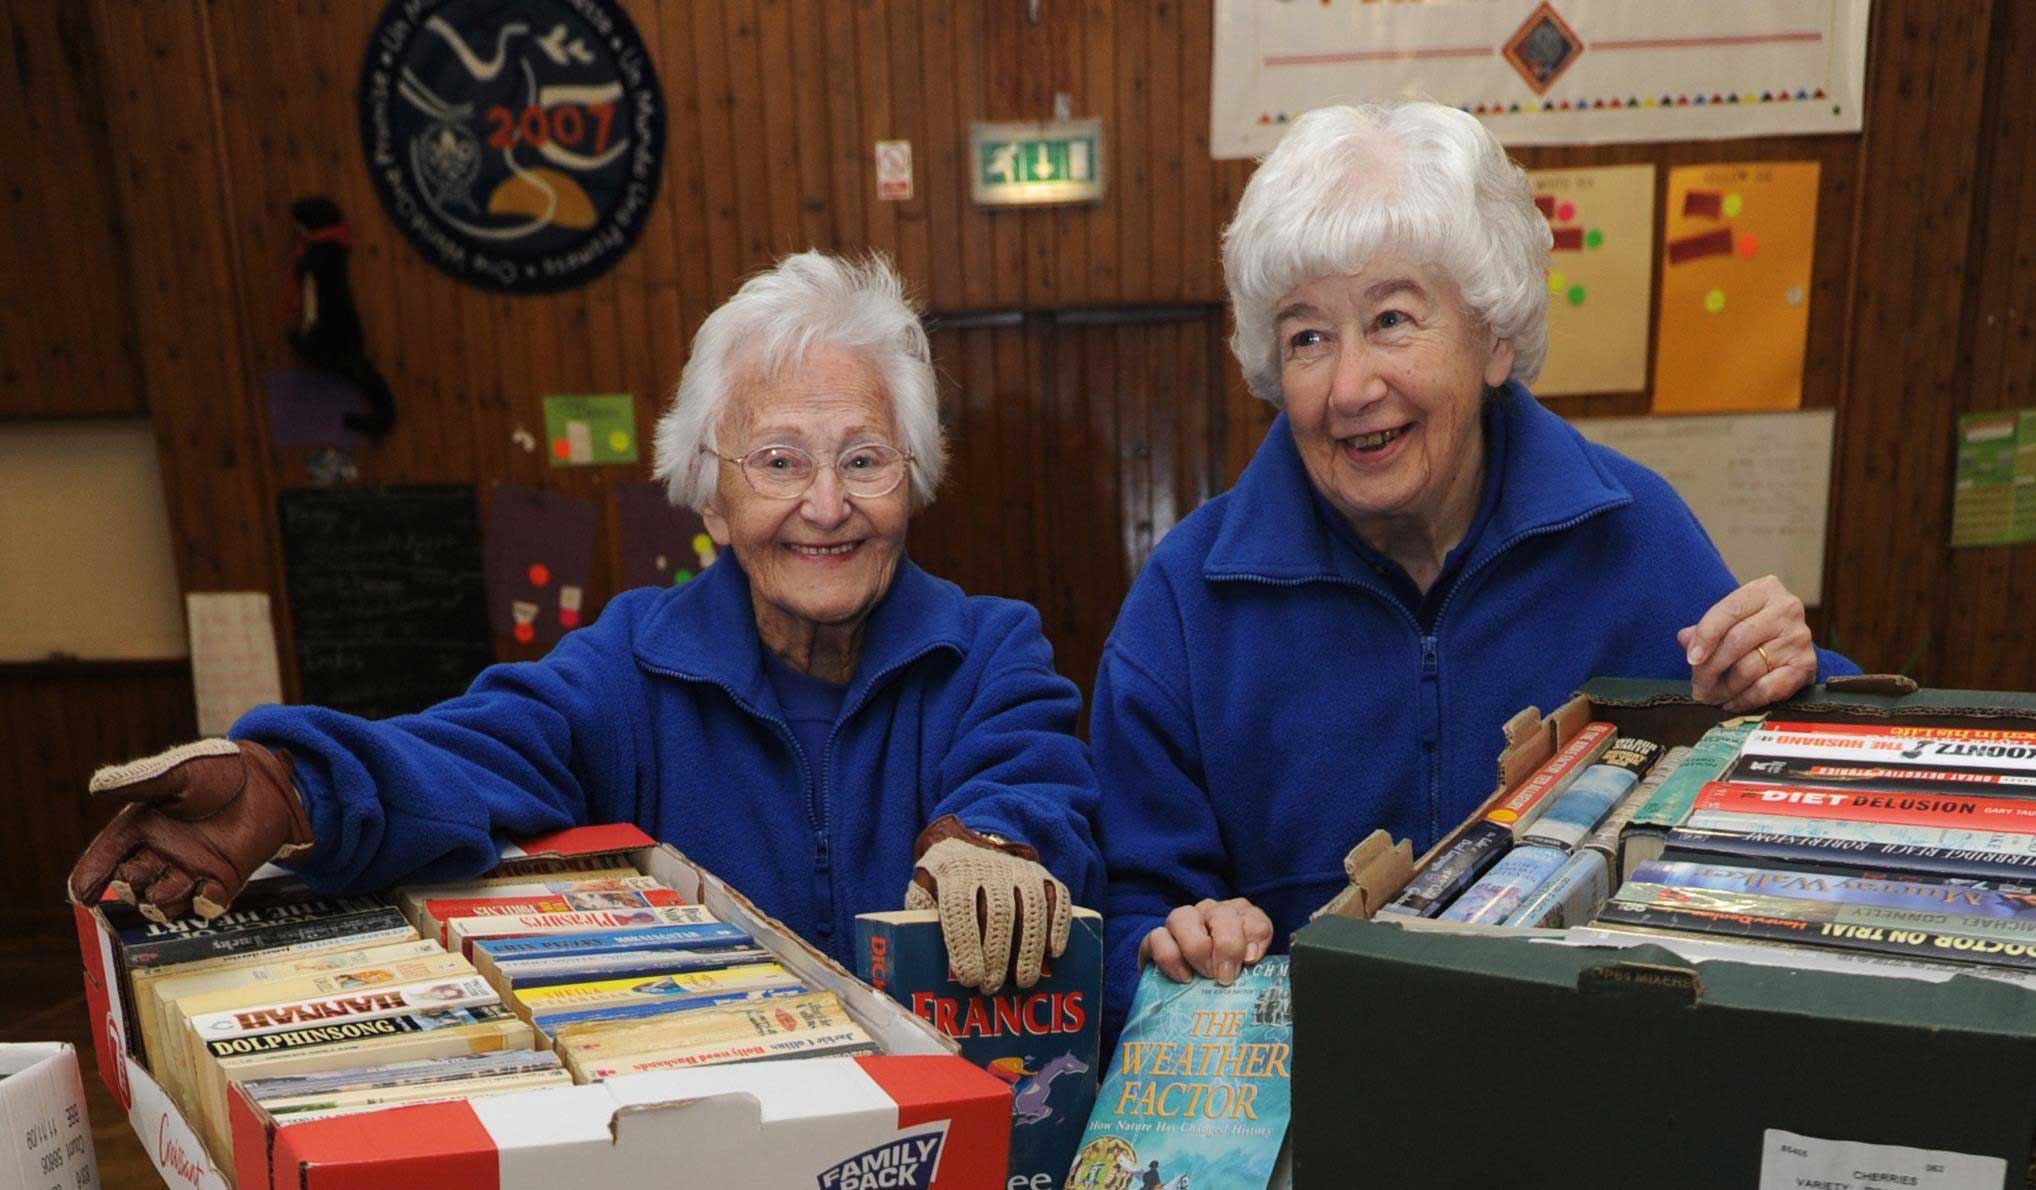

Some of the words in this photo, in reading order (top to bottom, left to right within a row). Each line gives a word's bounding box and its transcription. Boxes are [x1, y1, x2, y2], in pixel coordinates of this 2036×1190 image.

[486, 100, 616, 155] 2007
[1776, 734, 1865, 749] HUSBAND
[1890, 727, 1933, 737] Life
[1868, 737, 1903, 750] THE
[1818, 765, 1883, 778] STORIES
[1885, 768, 1953, 782] DETECTIVE
[1956, 771, 1992, 783] GREAT
[1760, 789, 1848, 807] DIET
[1852, 795, 1977, 814] DELUSION
[1983, 806, 2014, 816] GARY
[2016, 806, 2036, 817] TAU
[1806, 837, 1868, 852] ROBERT
[1882, 843, 1937, 858] REACH
[1699, 866, 1835, 896] Walker
[1836, 877, 1987, 906] Murray
[144, 909, 259, 938] HEART
[520, 910, 619, 933] Pleasures
[1762, 916, 1808, 930] Henry
[1850, 906, 1947, 927] CONNELLY
[1820, 921, 1885, 943] TRIAL
[1887, 929, 1929, 946] ON
[234, 990, 411, 1031] HANNAH
[912, 991, 1087, 1039] FRANCIS
[1191, 1009, 1246, 1038] THE
[212, 1019, 397, 1058] DOLPHINSONG
[769, 1037, 814, 1052] Collins
[816, 1031, 855, 1047] Jackie
[632, 1053, 695, 1072] Husbands
[697, 1045, 766, 1065] Hollywood
[1120, 1041, 1290, 1078] WEATHER
[1114, 1081, 1260, 1120] FACTOR
[1089, 1121, 1114, 1132] How
[1117, 1121, 1152, 1132] Nature
[1155, 1122, 1177, 1135] Has
[1179, 1122, 1228, 1136] Changed
[1231, 1124, 1274, 1138] History
[822, 1138, 938, 1188] FAMILY
[840, 1163, 920, 1190] PACK
[1853, 1170, 1919, 1186] CHERRIES
